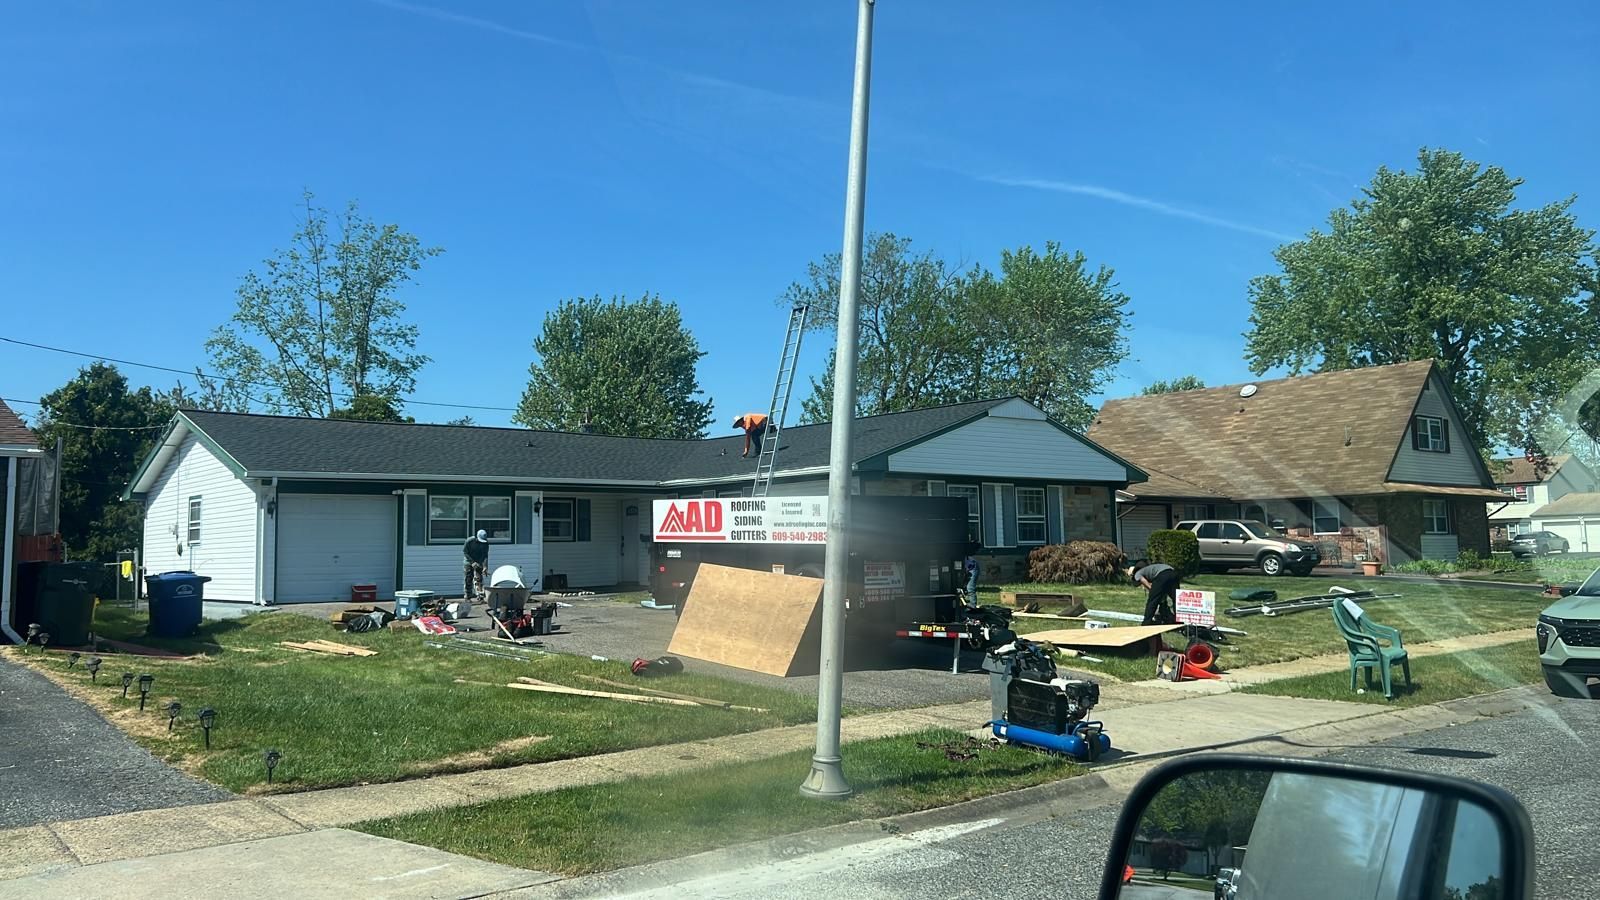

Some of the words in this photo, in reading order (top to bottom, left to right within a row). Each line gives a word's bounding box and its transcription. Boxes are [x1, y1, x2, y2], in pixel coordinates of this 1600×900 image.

[731, 500, 766, 512] ROOFING
[734, 515, 763, 527] SIDING
[731, 530, 767, 541] GUTTERS
